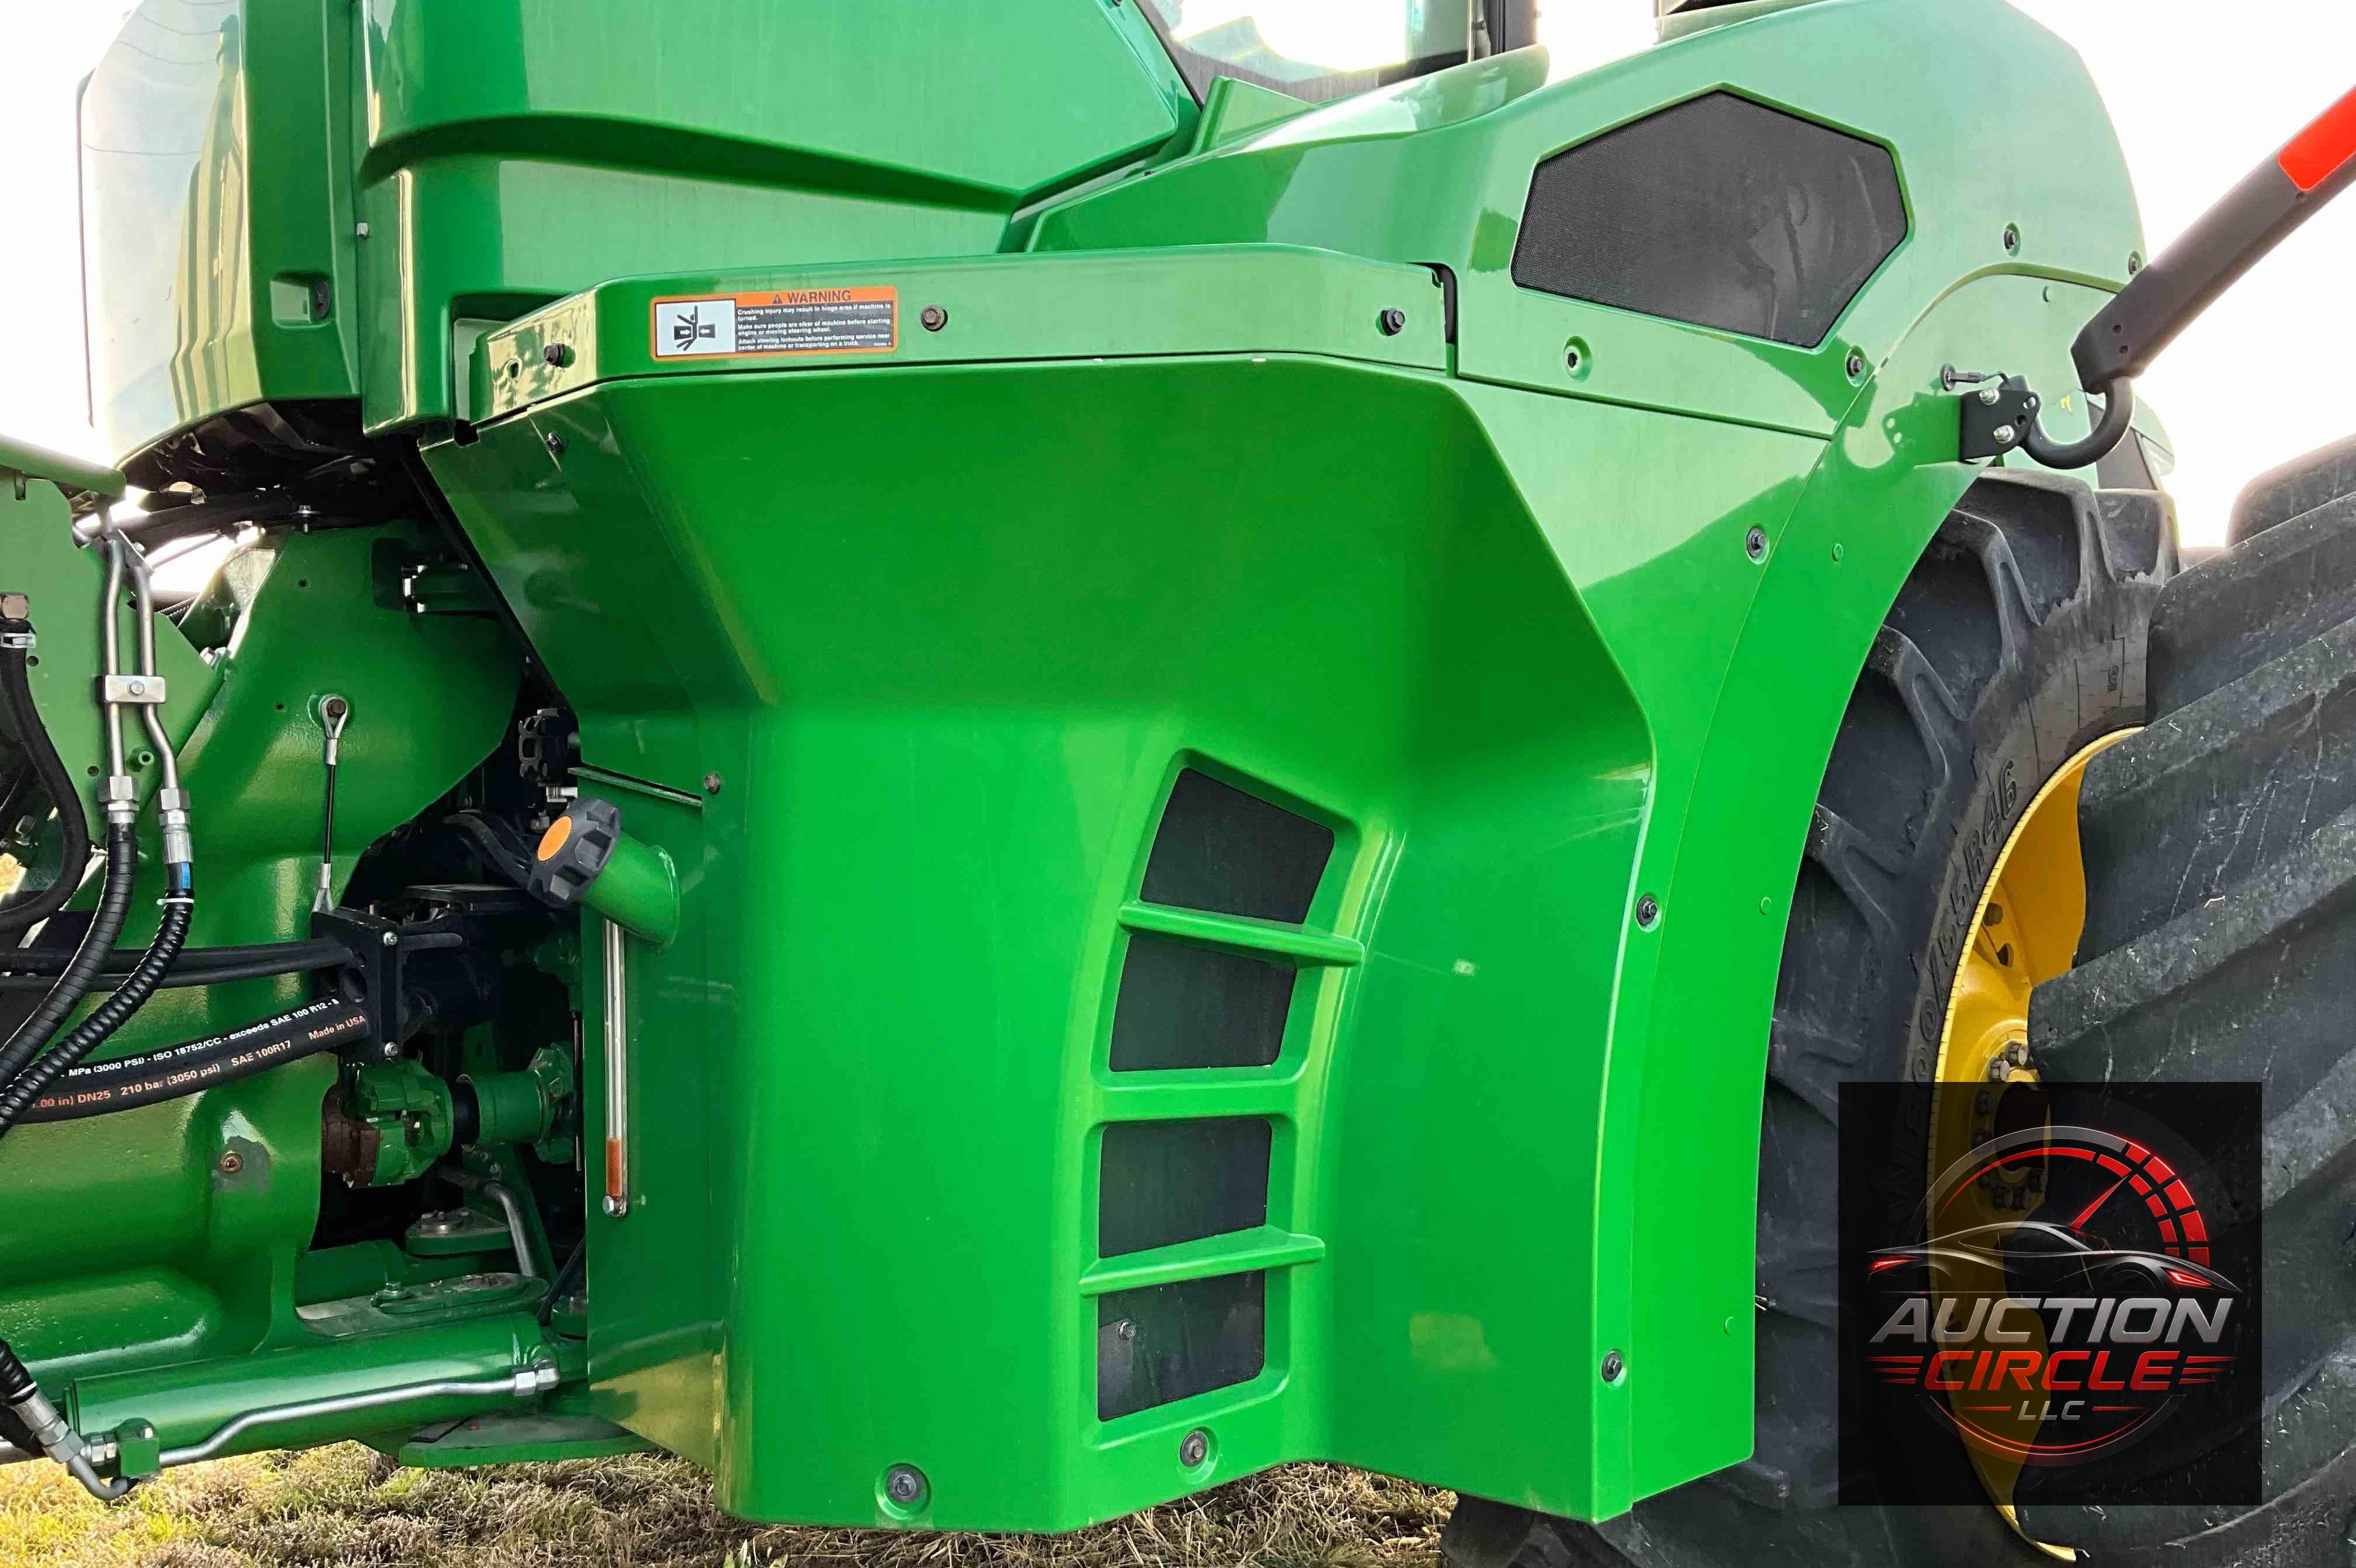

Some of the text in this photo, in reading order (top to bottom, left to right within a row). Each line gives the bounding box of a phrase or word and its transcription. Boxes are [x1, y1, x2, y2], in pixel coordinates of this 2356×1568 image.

[787, 290, 851, 303] WARNING
[58, 1095, 74, 1106] in)
[77, 1090, 111, 1104] DN25
[120, 1084, 141, 1096] 210
[144, 1080, 164, 1091] bar
[167, 1070, 197, 1086] (3050
[199, 1063, 220, 1077] psi)
[230, 1052, 254, 1067] SAE
[255, 1039, 290, 1058] 100R17
[308, 1027, 334, 1040] Made
[335, 1022, 345, 1032] in
[346, 1015, 365, 1027] USA
[68, 1067, 92, 1077] MPa
[93, 1062, 122, 1073] (3000
[124, 1057, 145, 1068] PSI)
[153, 1050, 172, 1061] ISO
[174, 1038, 221, 1056] 18752/CC
[229, 1022, 270, 1040] exceeds
[270, 1014, 292, 1027] SAE
[292, 1008, 309, 1019] 100
[309, 1002, 328, 1014] R12
